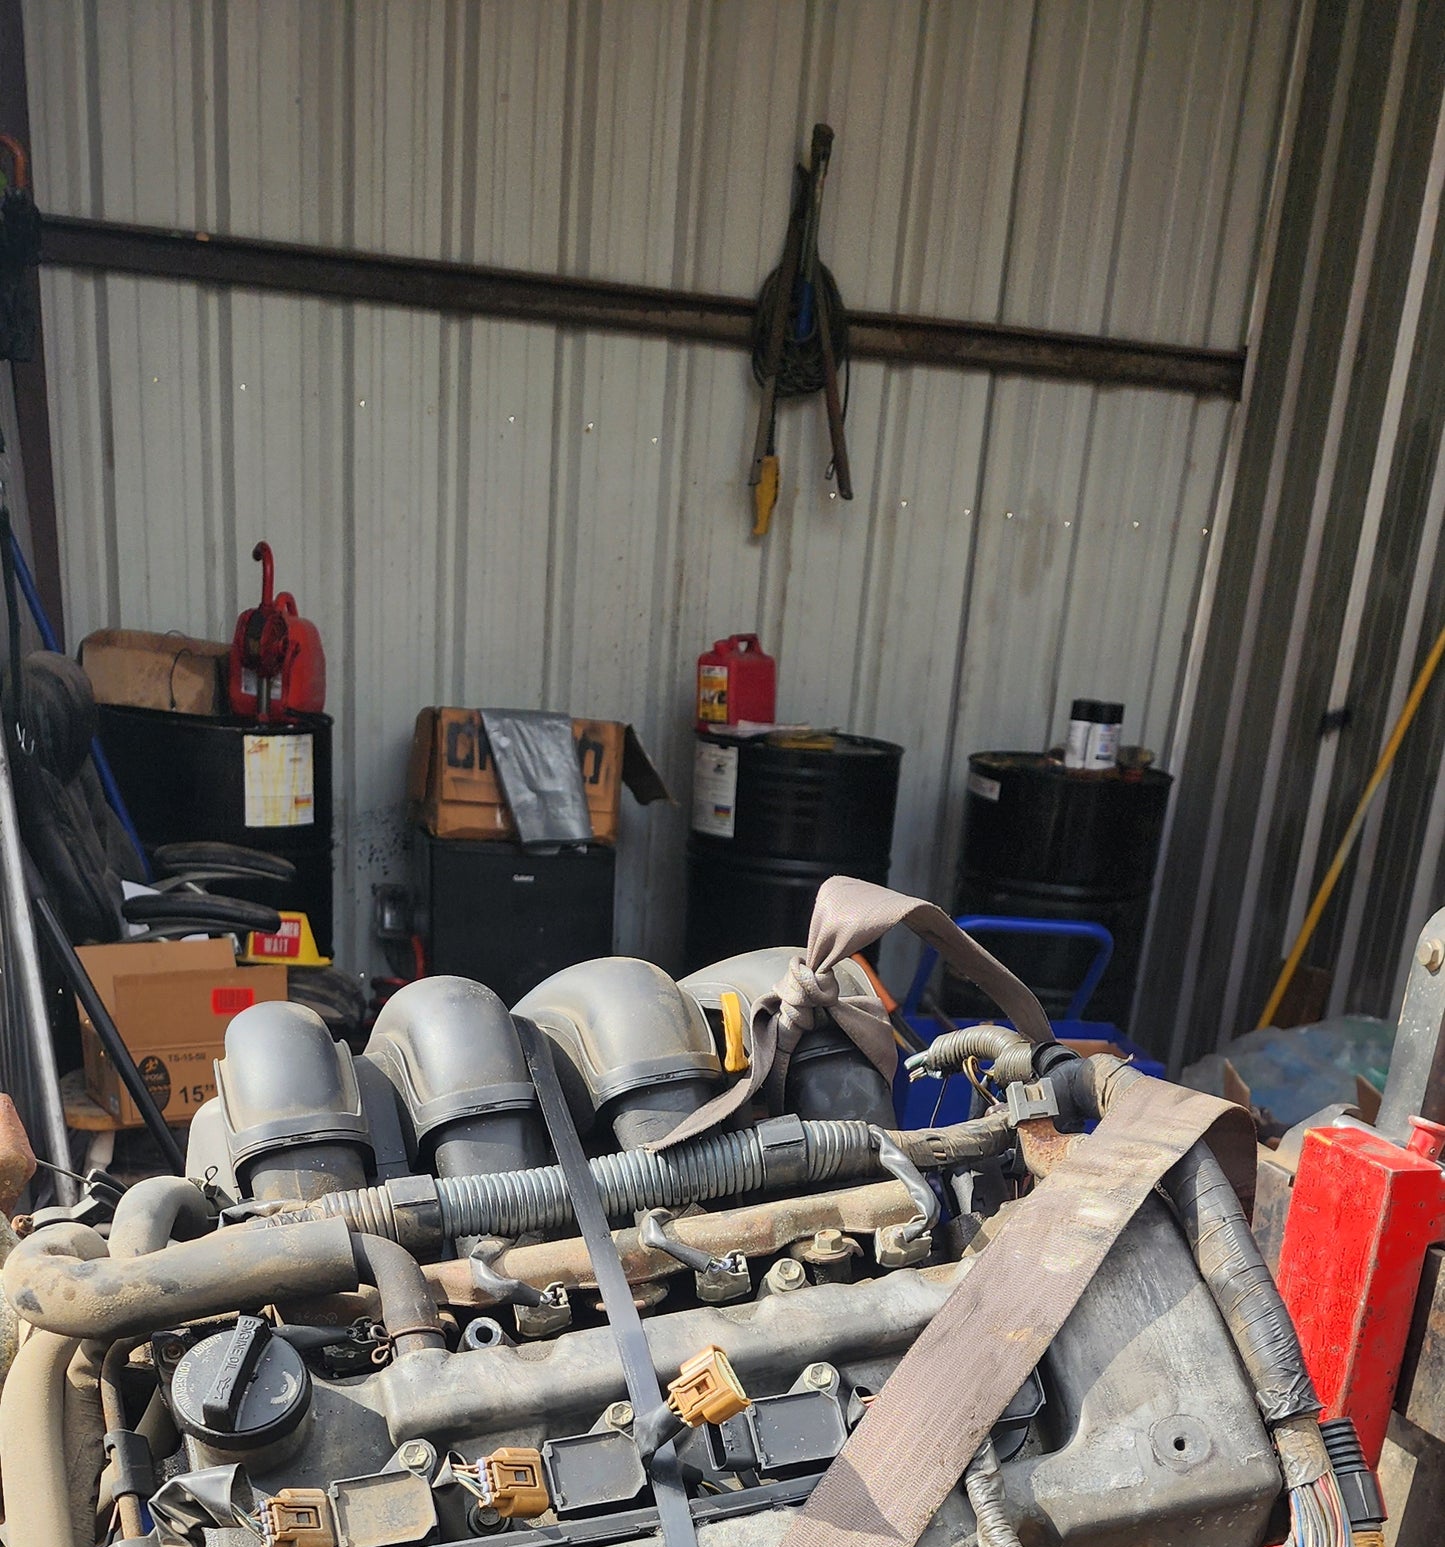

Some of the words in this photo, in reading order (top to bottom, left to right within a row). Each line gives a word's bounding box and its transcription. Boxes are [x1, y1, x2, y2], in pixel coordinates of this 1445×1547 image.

[264, 937, 289, 953] WAIT
[191, 1335, 223, 1358] ENERGY
[232, 1319, 256, 1356] ENGINE
[225, 1356, 241, 1372] OIL
[176, 1361, 191, 1409] CONSERVING
